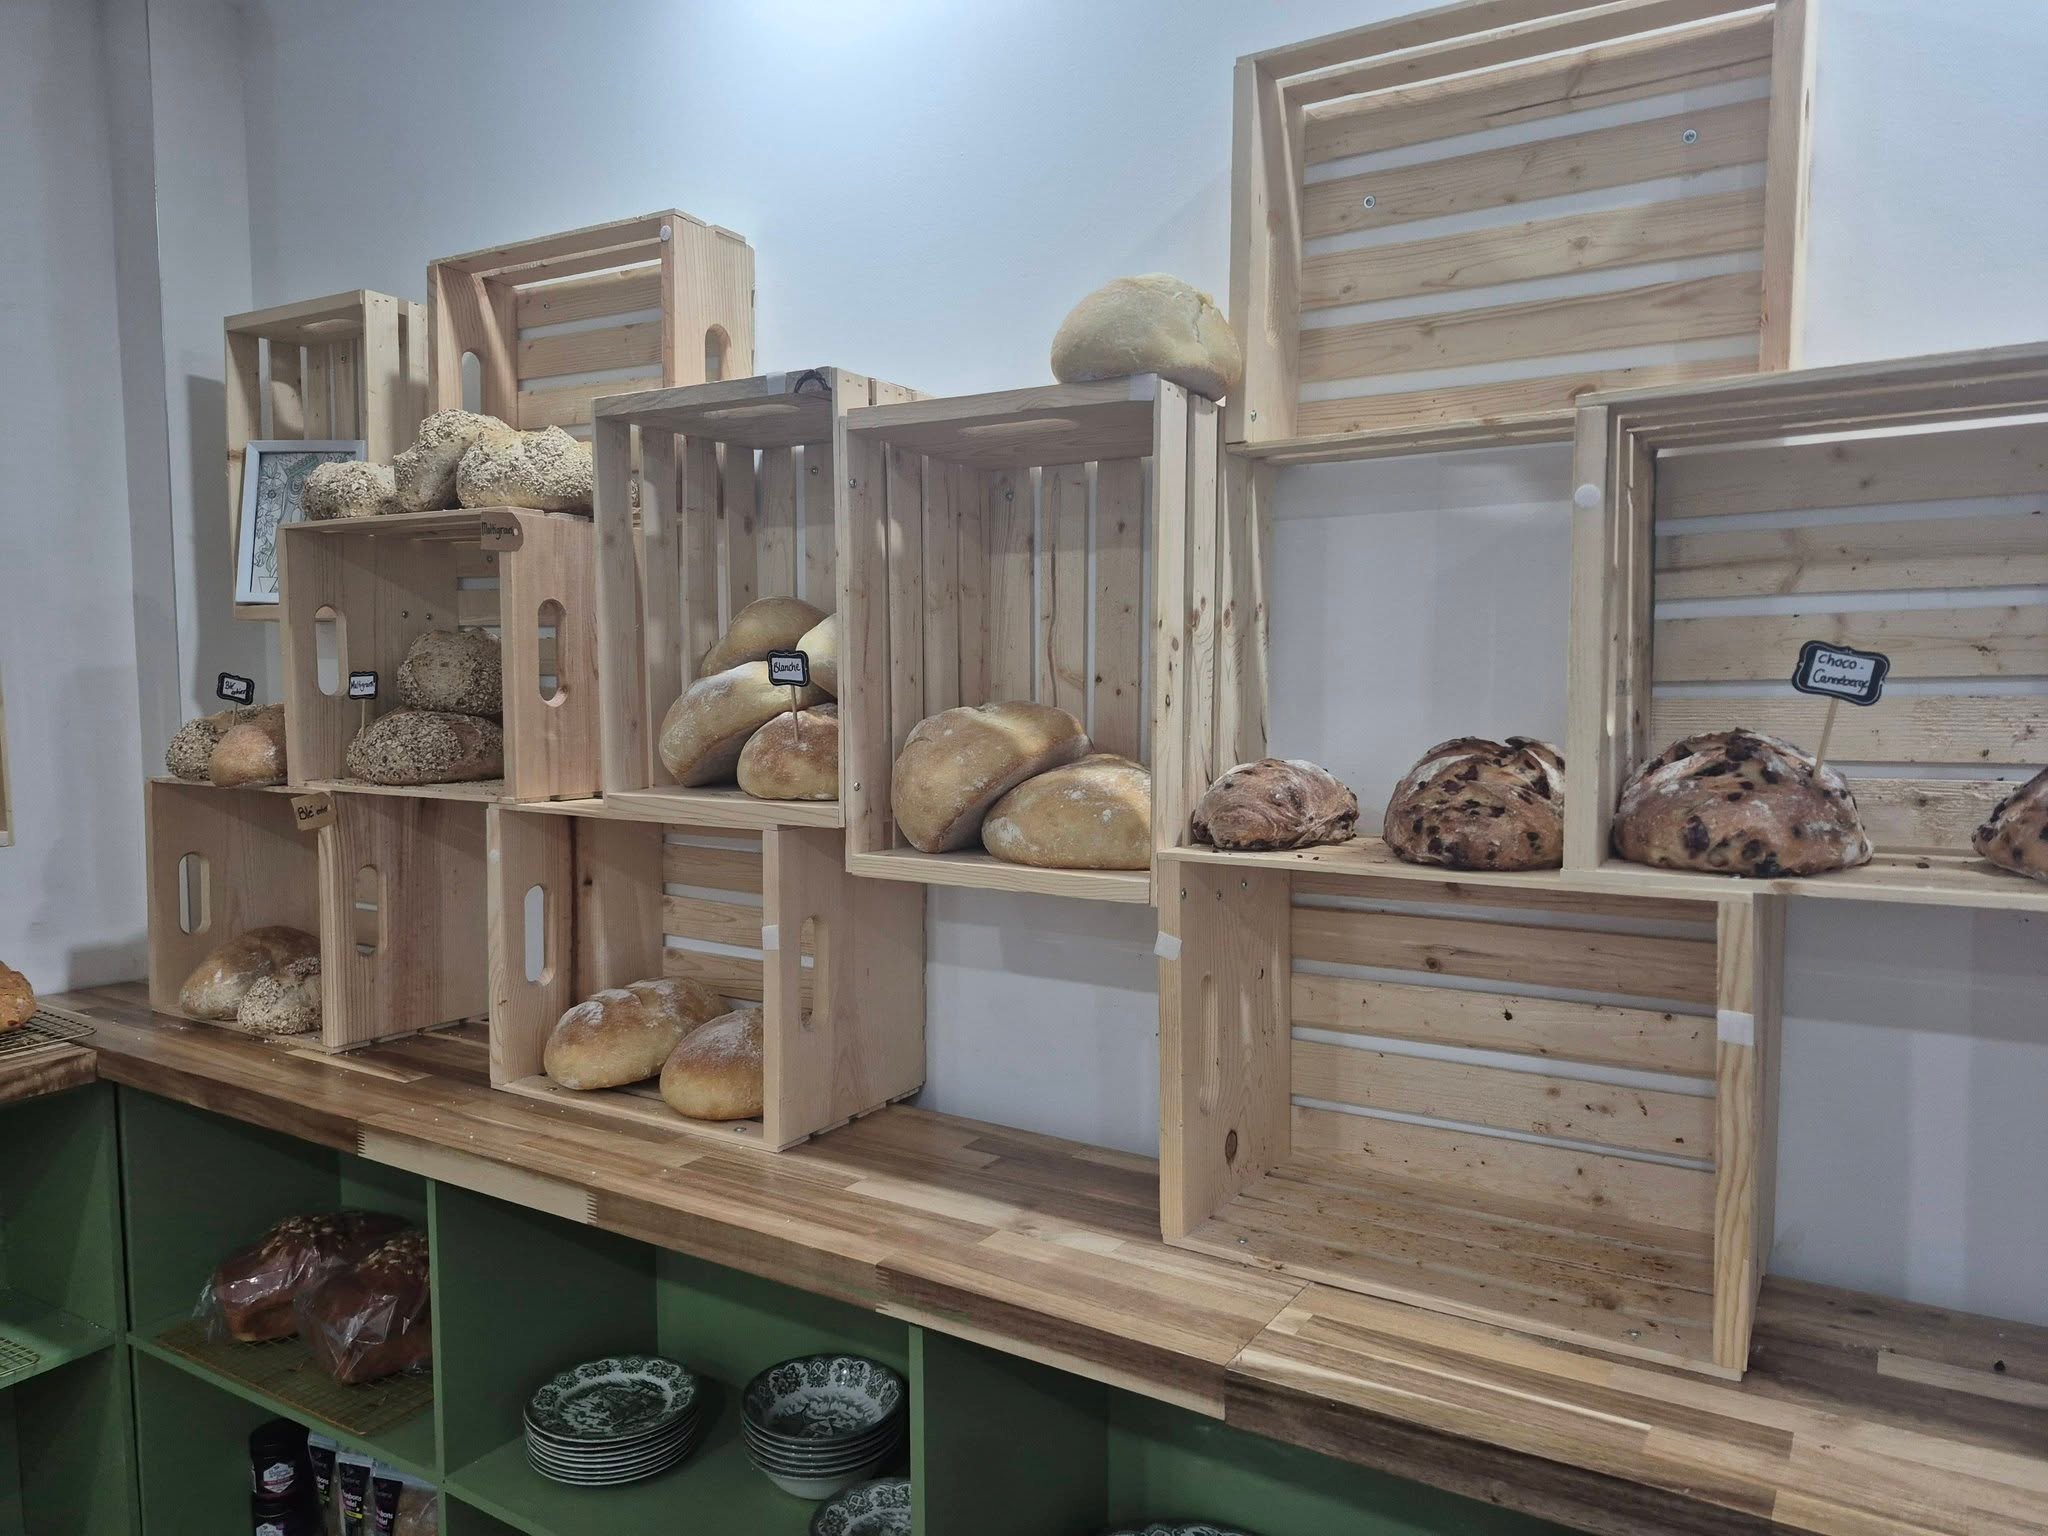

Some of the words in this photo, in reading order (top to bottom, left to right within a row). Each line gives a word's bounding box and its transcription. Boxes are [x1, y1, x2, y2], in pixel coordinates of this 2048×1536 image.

[773, 661, 801, 673] Blanche
[1818, 653, 1857, 670] Choco
[297, 804, 315, 821] Blé
